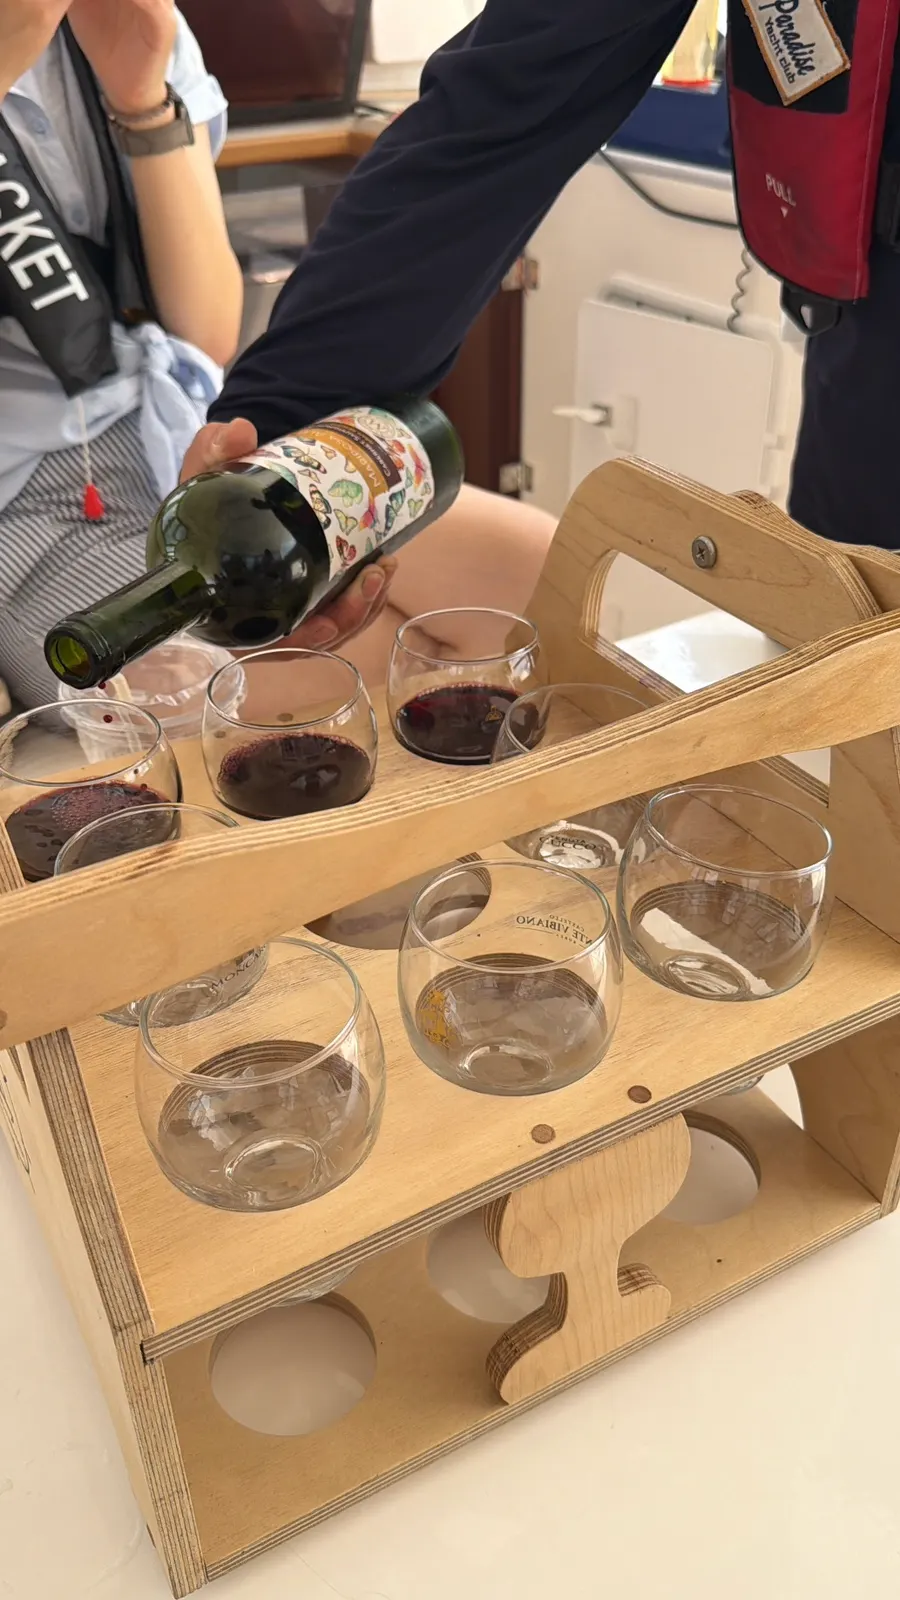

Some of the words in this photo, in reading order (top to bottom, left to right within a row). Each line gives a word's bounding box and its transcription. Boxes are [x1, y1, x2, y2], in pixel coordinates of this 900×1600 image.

[759, 0, 816, 76] Paradise
[765, 16, 783, 57] Yacht
[765, 172, 797, 207] PULL
[0, 153, 89, 310] CKET
